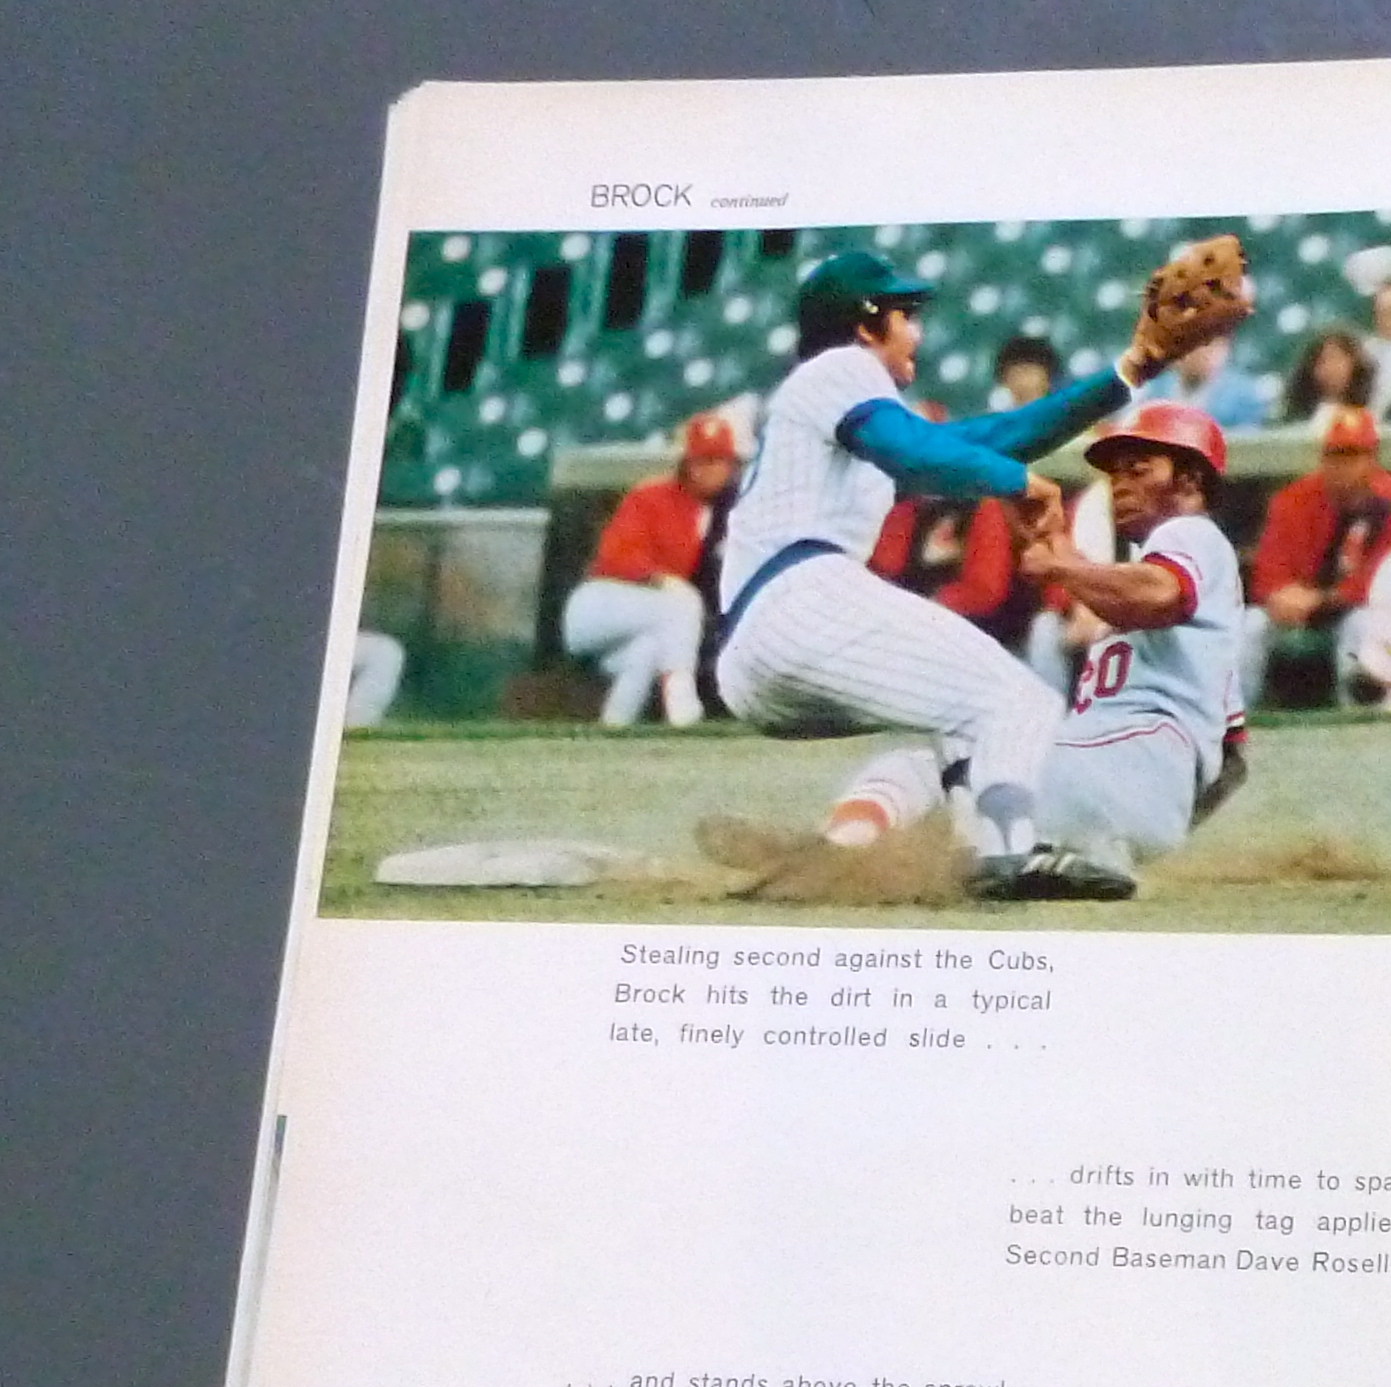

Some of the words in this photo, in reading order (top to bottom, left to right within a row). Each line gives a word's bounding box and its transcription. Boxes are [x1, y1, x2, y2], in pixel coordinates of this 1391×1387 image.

[590, 183, 692, 208] BROCK
[711, 192, 788, 209] continued
[620, 943, 720, 970] Stealing
[733, 947, 821, 967] second
[834, 948, 923, 973] against
[935, 949, 973, 970] the
[988, 949, 1055, 974] Cubs,
[614, 982, 686, 1004] Brock
[706, 984, 749, 1005] hits
[769, 985, 809, 1006] the
[830, 987, 872, 1008] dirt
[893, 987, 913, 1008] in
[933, 993, 948, 1009] a
[971, 989, 1051, 1015] typical
[609, 1022, 659, 1047] late,
[680, 1022, 745, 1050] finely
[763, 1025, 888, 1048] controlled
[908, 1027, 966, 1049] slide
[1069, 1164, 1135, 1186] drifts
[1149, 1166, 1169, 1187] in
[1183, 1167, 1234, 1188] with
[1248, 1169, 1302, 1190] time
[1316, 1169, 1340, 1191] to
[1009, 1204, 1065, 1225] beat
[1083, 1205, 1122, 1227] the
[1142, 1206, 1232, 1234] lunging
[1255, 1209, 1294, 1236] tag
[1005, 1243, 1100, 1267] Second
[1112, 1246, 1226, 1270] Baseman
[1236, 1249, 1300, 1272] Dave
